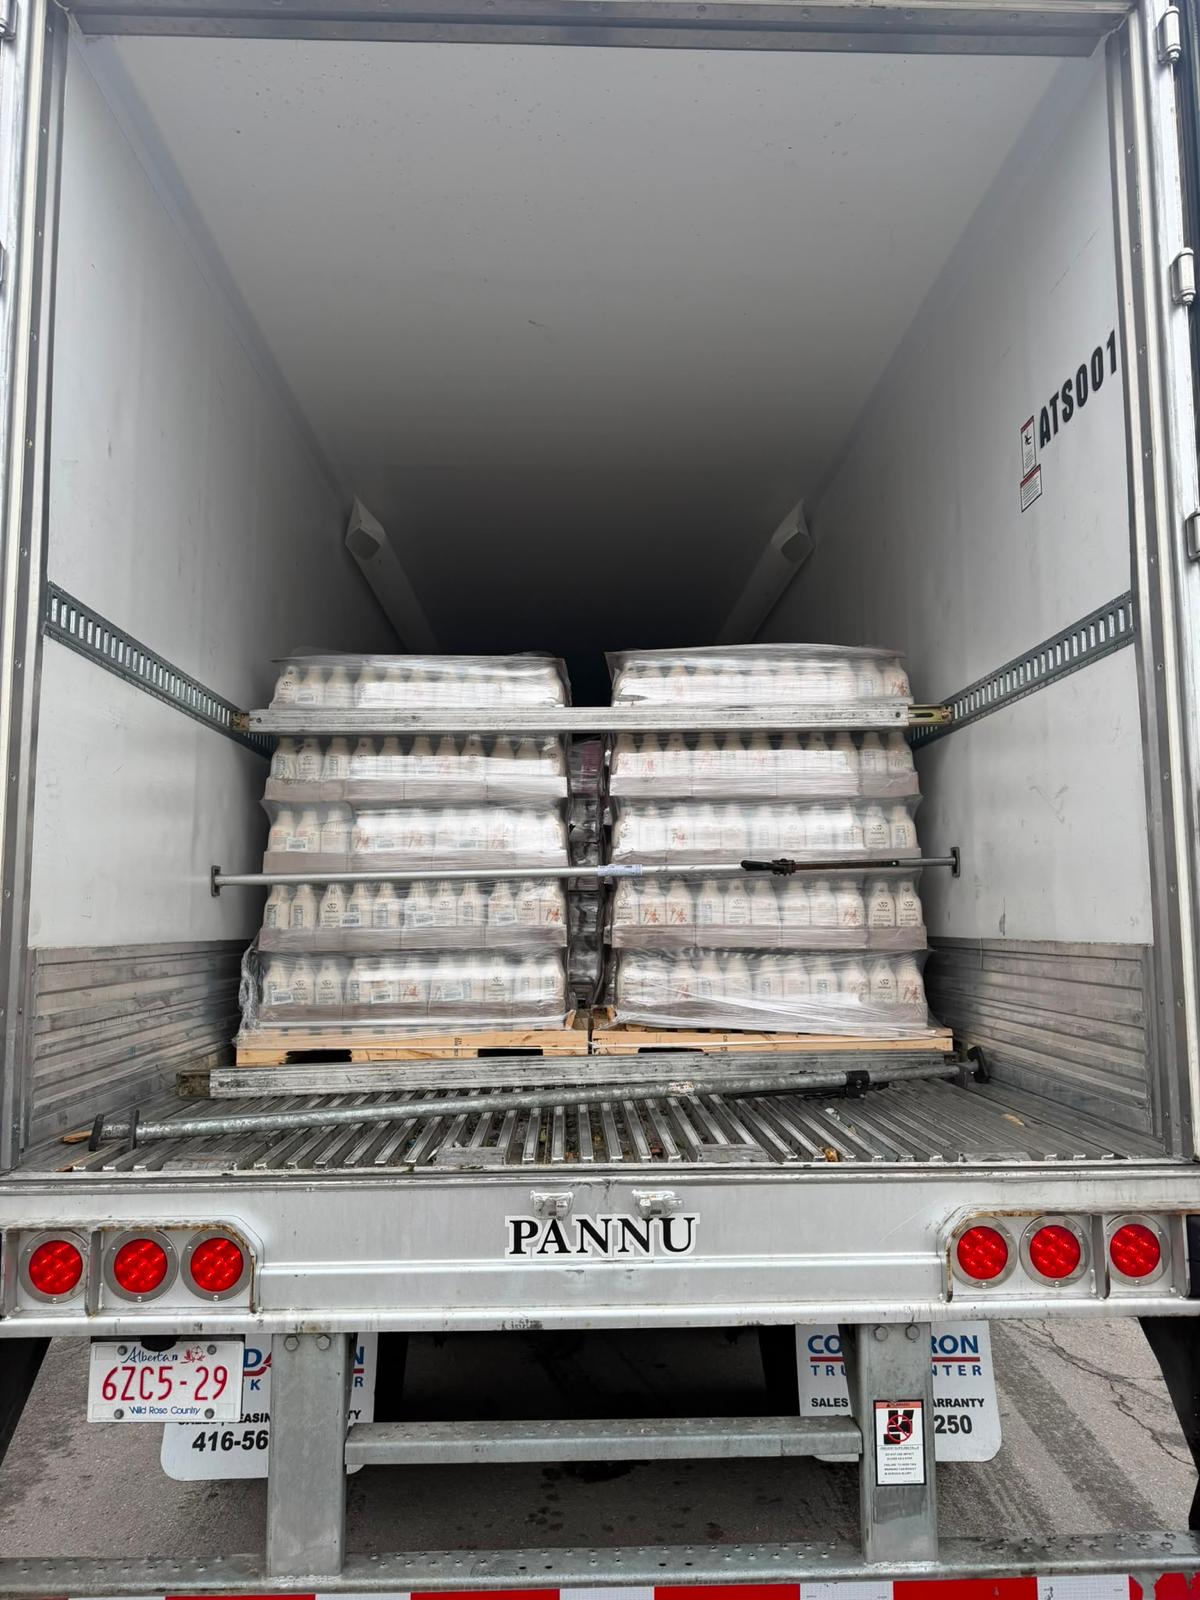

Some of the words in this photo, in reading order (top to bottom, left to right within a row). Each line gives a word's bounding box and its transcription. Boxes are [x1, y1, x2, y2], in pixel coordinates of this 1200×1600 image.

[1039, 329, 1117, 449] ATS001
[509, 1217, 696, 1255] PANNU
[120, 1346, 169, 1364] Alberta
[101, 1365, 228, 1401] 6ZC5-29
[129, 1406, 147, 1415] Wild
[149, 1406, 168, 1415] Rose
[170, 1406, 201, 1416] Country
[811, 1397, 849, 1408] SALES
[933, 1414, 973, 1435] 250
[192, 1429, 269, 1452] 416-56
